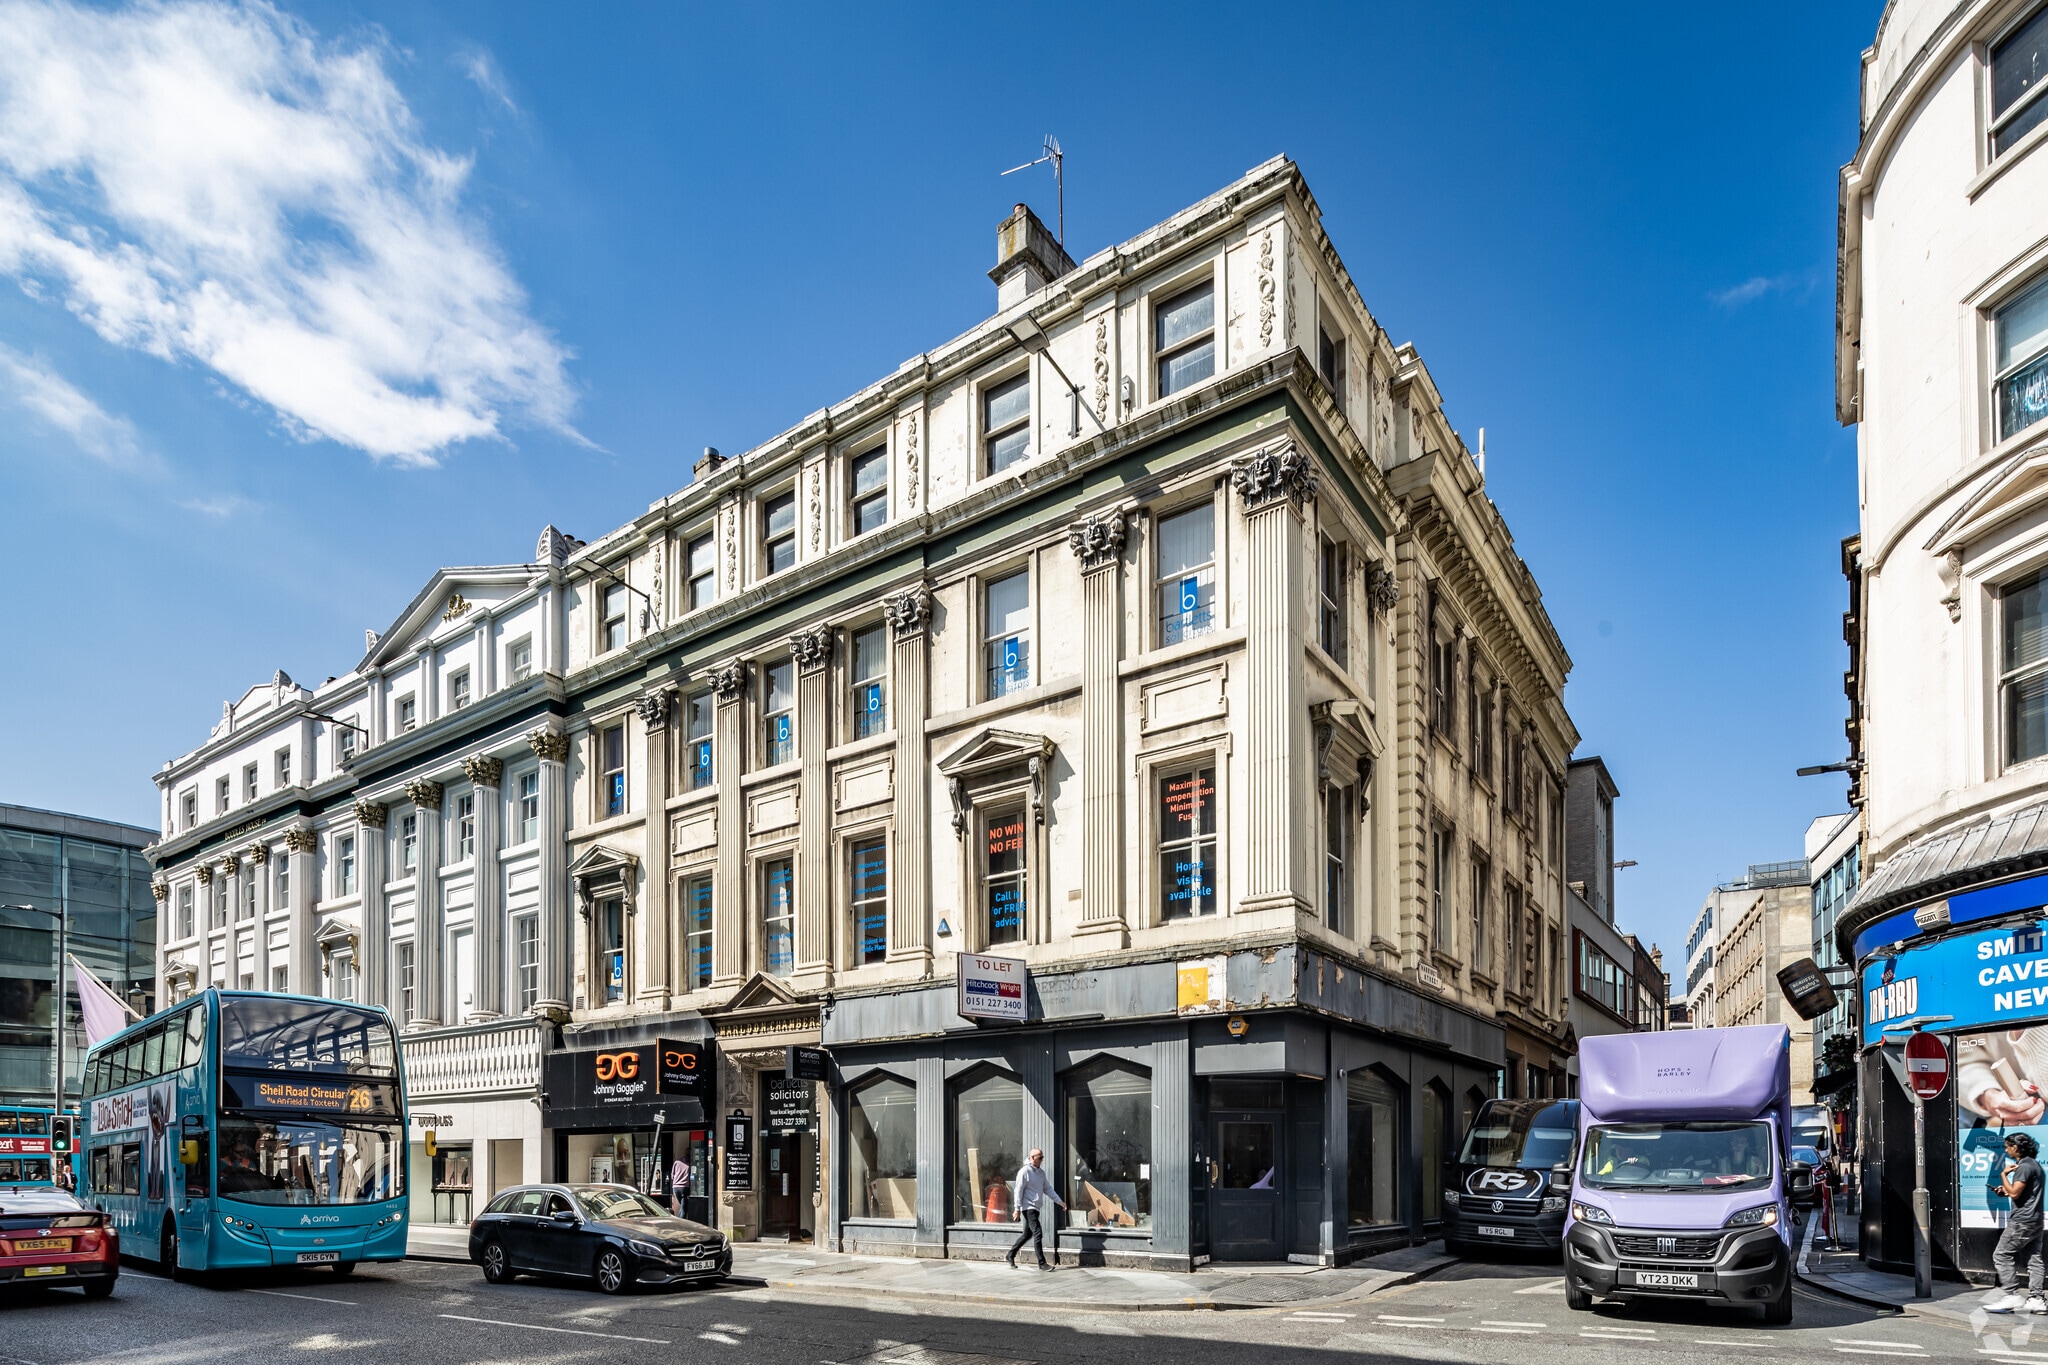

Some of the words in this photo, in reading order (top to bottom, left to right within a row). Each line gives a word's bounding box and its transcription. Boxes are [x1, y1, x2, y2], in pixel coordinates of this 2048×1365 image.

[1168, 777, 1206, 792] Maximum
[1165, 786, 1215, 803] ompensation
[1169, 799, 1206, 814] Minimum
[989, 827, 1003, 840] NO
[1004, 822, 1024, 837] WIN
[990, 841, 1004, 854] NO
[1005, 838, 1024, 851] FEE
[1175, 860, 1204, 873] Home
[1176, 874, 1203, 886] visits
[995, 890, 1012, 902] Call
[1168, 886, 1212, 901] available
[1004, 901, 1027, 914] FREE
[995, 917, 1022, 929] advice
[1916, 913, 1938, 926] PIGGOTT
[976, 960, 990, 970] TO
[993, 962, 1012, 972] LET
[966, 979, 1000, 990] Hitchcock
[1000, 983, 1021, 993] Wright
[966, 996, 985, 1006] 0151
[987, 998, 1002, 1008] 227
[1003, 1000, 1022, 1010] 3400
[1868, 976, 1918, 1026] IRN-BRU
[260, 1083, 284, 1096] Sheil
[285, 1085, 309, 1098] Road
[310, 1087, 346, 1100] Circular
[593, 1083, 616, 1096] Johnny
[615, 1082, 644, 1095] Goggles
[770, 1089, 809, 1100] solicitors
[276, 1097, 303, 1106] Anfield
[302, 1098, 309, 1106] &
[310, 1099, 340, 1108] Toxteth
[349, 1089, 371, 1109] 26
[787, 1108, 795, 1116] legal
[771, 1117, 795, 1126] 0151-227
[794, 1117, 807, 1126] 3391
[1975, 1135, 2006, 1144] IQOS
[1479, 1171, 1528, 1191] RG
[312, 1213, 340, 1223] arriva
[1494, 1227, 1508, 1236] RGL
[19, 1241, 45, 1250] VX65
[1656, 1237, 1678, 1253] FIAT
[301, 1254, 319, 1262] SK15
[319, 1253, 335, 1261] GYN
[1640, 1273, 1669, 1285] YT23
[1671, 1275, 1694, 1286] DKK
